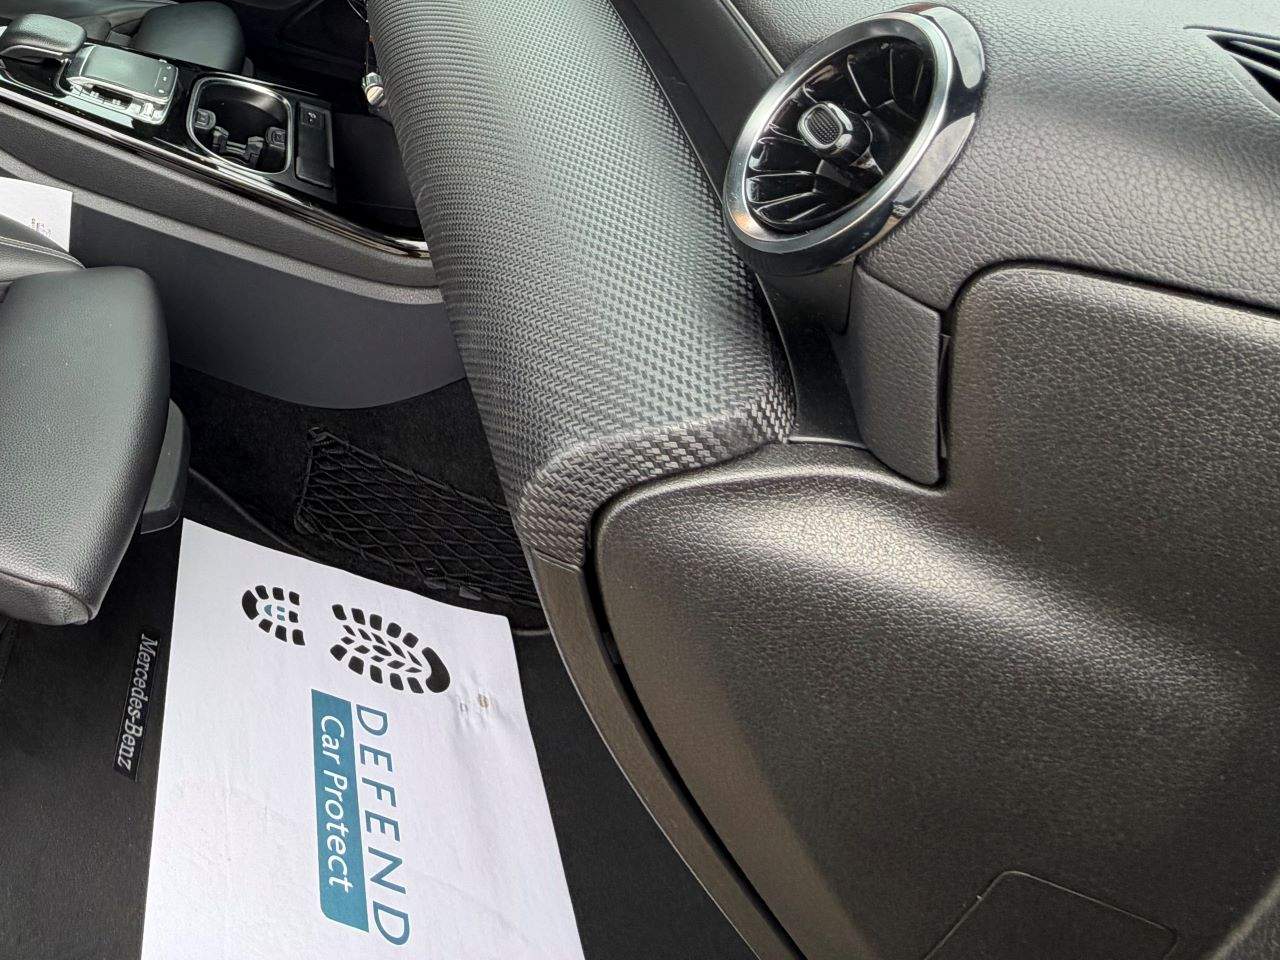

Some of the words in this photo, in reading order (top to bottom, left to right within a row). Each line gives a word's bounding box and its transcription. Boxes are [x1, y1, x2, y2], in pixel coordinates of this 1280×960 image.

[118, 633, 158, 771] Mercedes-Benz
[321, 715, 345, 765] Car
[323, 769, 354, 894] Protect
[356, 704, 410, 946] DEFEND
